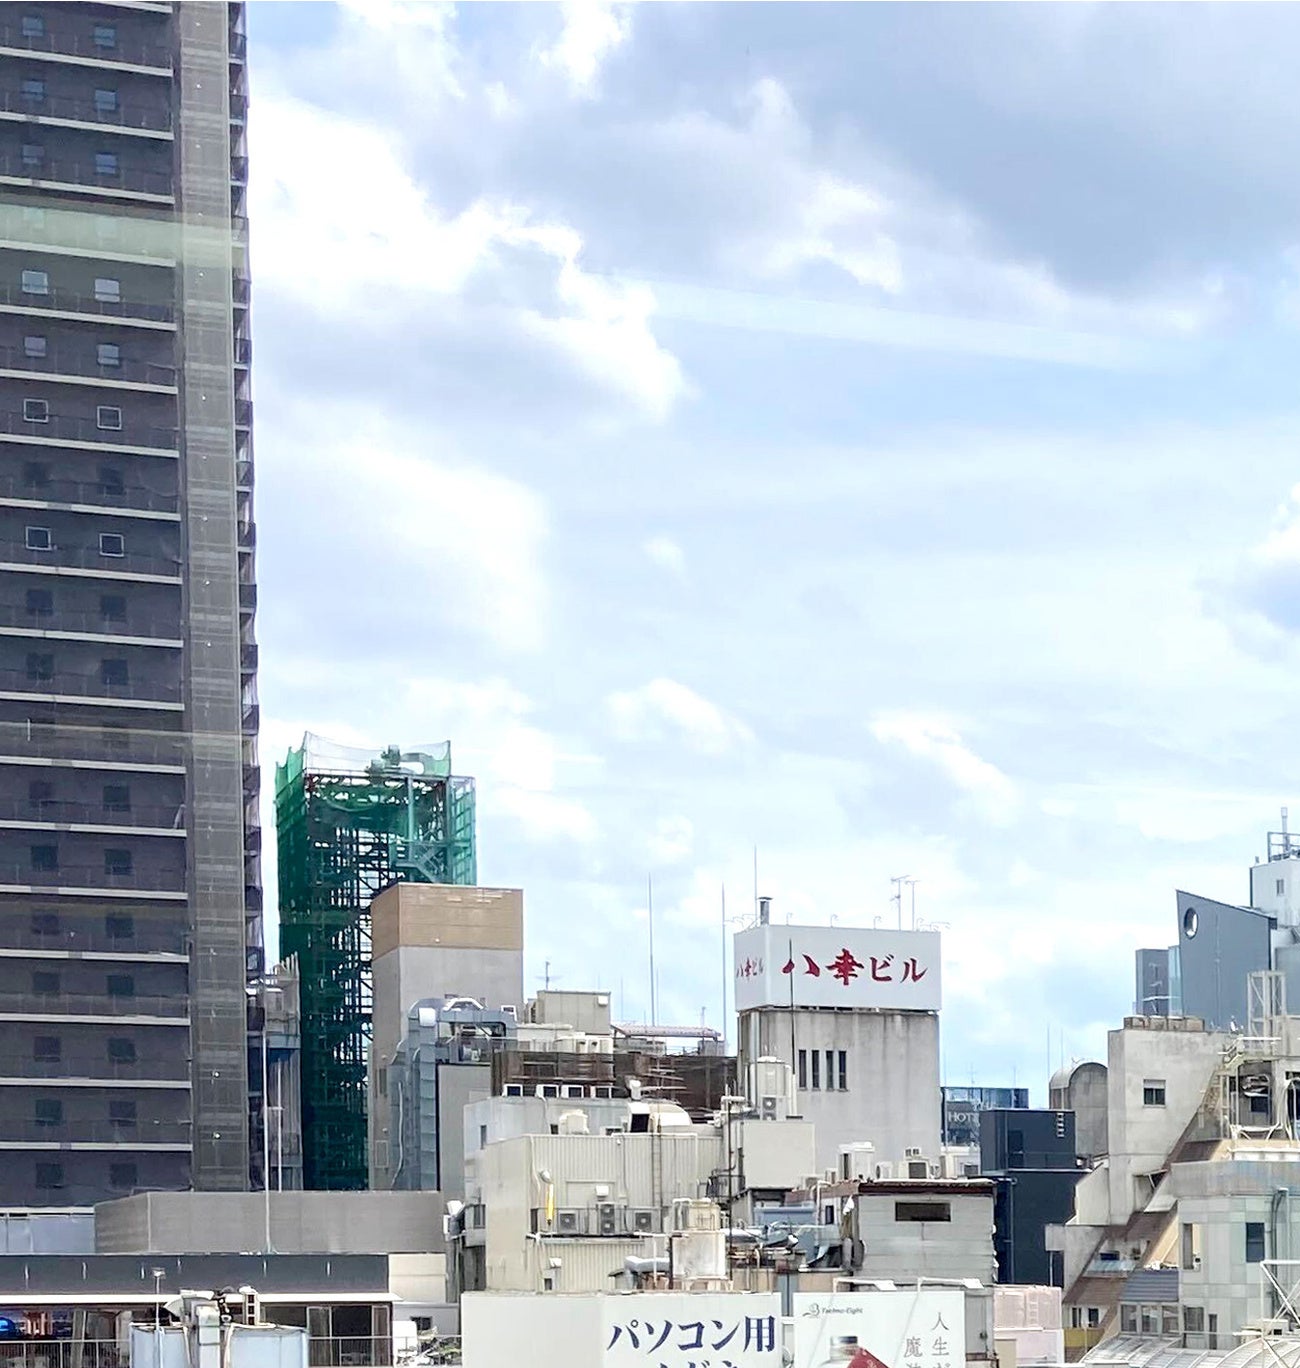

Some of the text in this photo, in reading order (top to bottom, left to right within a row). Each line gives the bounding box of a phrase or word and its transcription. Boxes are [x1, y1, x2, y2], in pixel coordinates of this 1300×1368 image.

[780, 947, 929, 986] 八幸ビル
[605, 1315, 777, 1356] パソコン用
